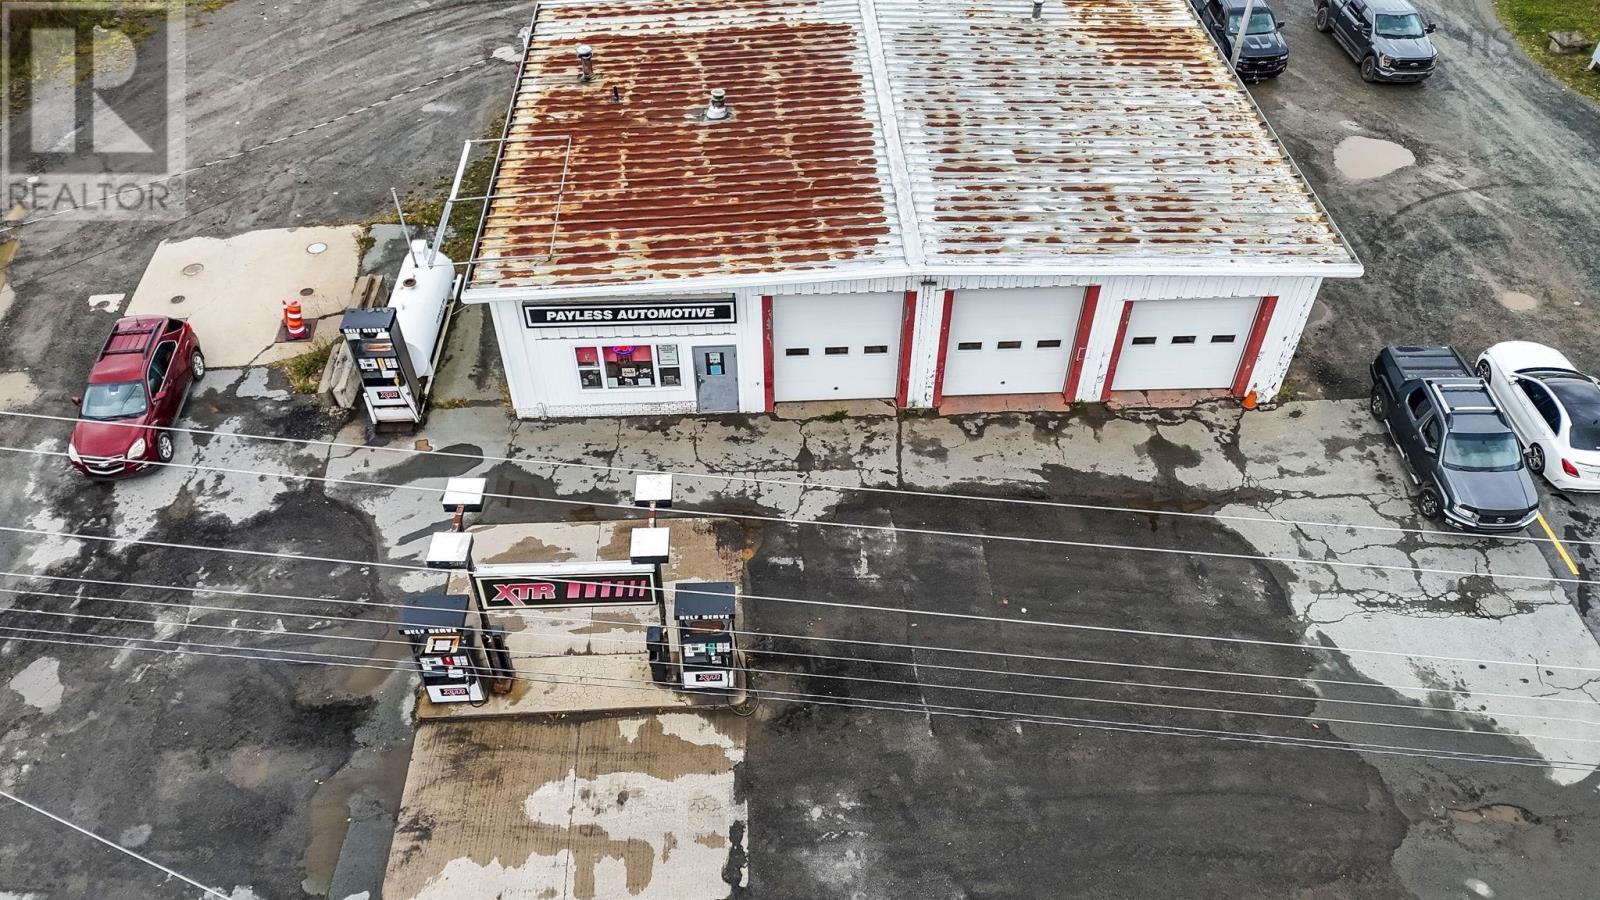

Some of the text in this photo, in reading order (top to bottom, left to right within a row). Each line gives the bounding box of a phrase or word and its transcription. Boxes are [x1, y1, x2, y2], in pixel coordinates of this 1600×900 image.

[546, 307, 715, 321] PAYLESS AUTOMOTIVE
[492, 583, 556, 607] XTR
